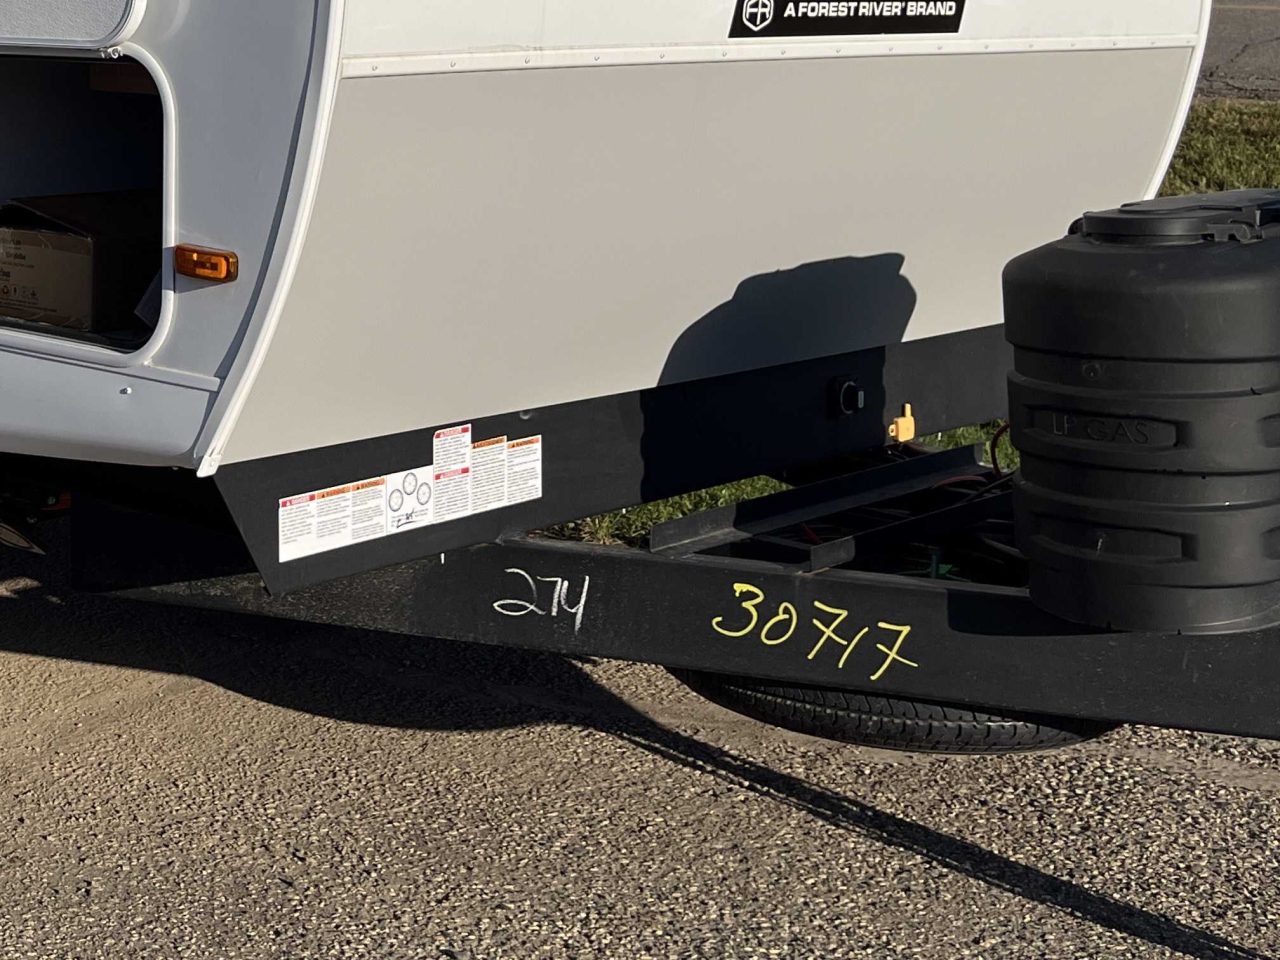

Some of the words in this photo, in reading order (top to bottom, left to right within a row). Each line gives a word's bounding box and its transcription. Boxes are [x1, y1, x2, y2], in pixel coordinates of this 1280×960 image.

[783, 1, 796, 17] A
[797, 1, 858, 17] FOREST
[906, 1, 956, 17] BRAND
[1086, 418, 1150, 444] GAS
[492, 567, 589, 635] 274
[712, 582, 918, 680] 30717
